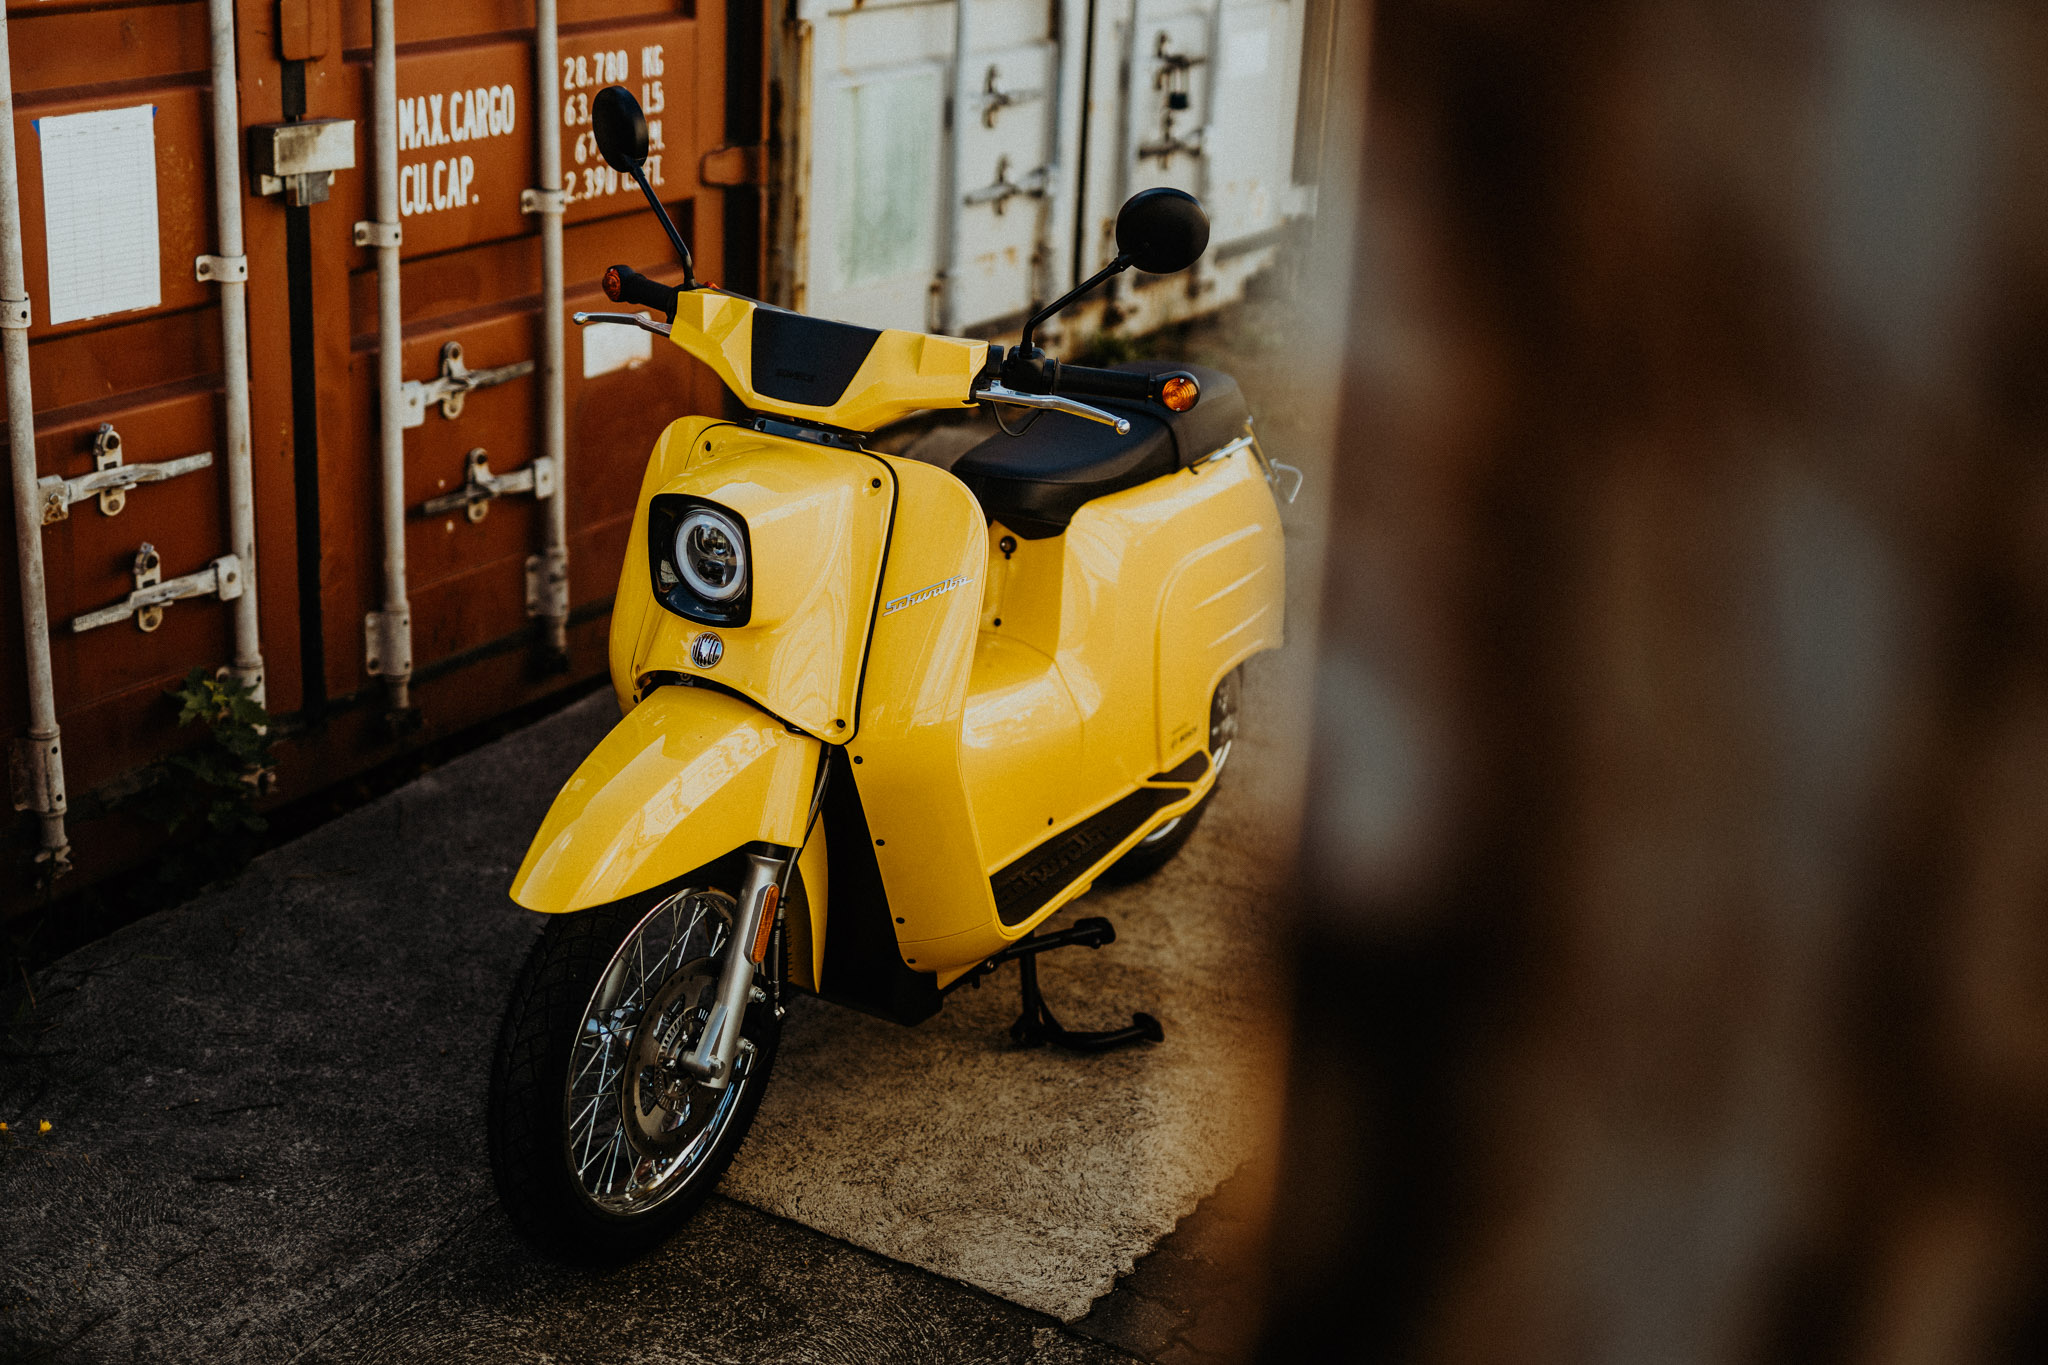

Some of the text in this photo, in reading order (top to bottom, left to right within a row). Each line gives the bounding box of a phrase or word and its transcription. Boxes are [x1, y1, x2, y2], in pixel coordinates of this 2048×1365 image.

[642, 44, 664, 79] KG
[399, 84, 515, 151] MAX.CARGO
[400, 155, 480, 216] CU.CAP.
[563, 165, 618, 204] 2.390
[882, 575, 975, 617] Schwalbe
